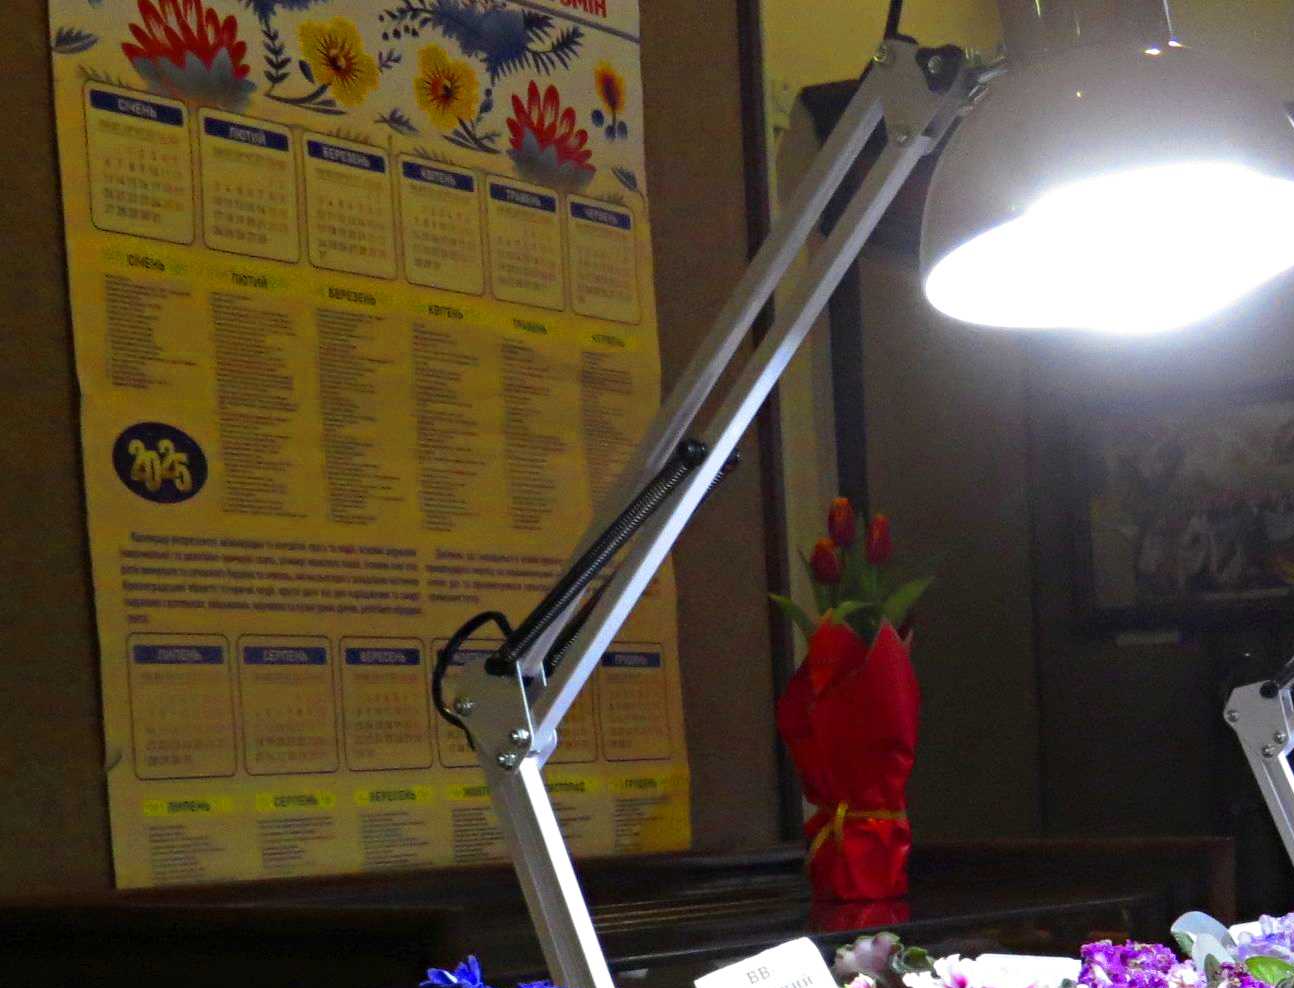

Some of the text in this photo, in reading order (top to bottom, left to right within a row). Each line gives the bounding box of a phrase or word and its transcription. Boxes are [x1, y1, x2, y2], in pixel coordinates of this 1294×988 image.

[127, 253, 165, 272] СІЧЕНЬ
[328, 287, 377, 306] БЕРЕЗЕНЬ
[128, 438, 192, 493] 2025
